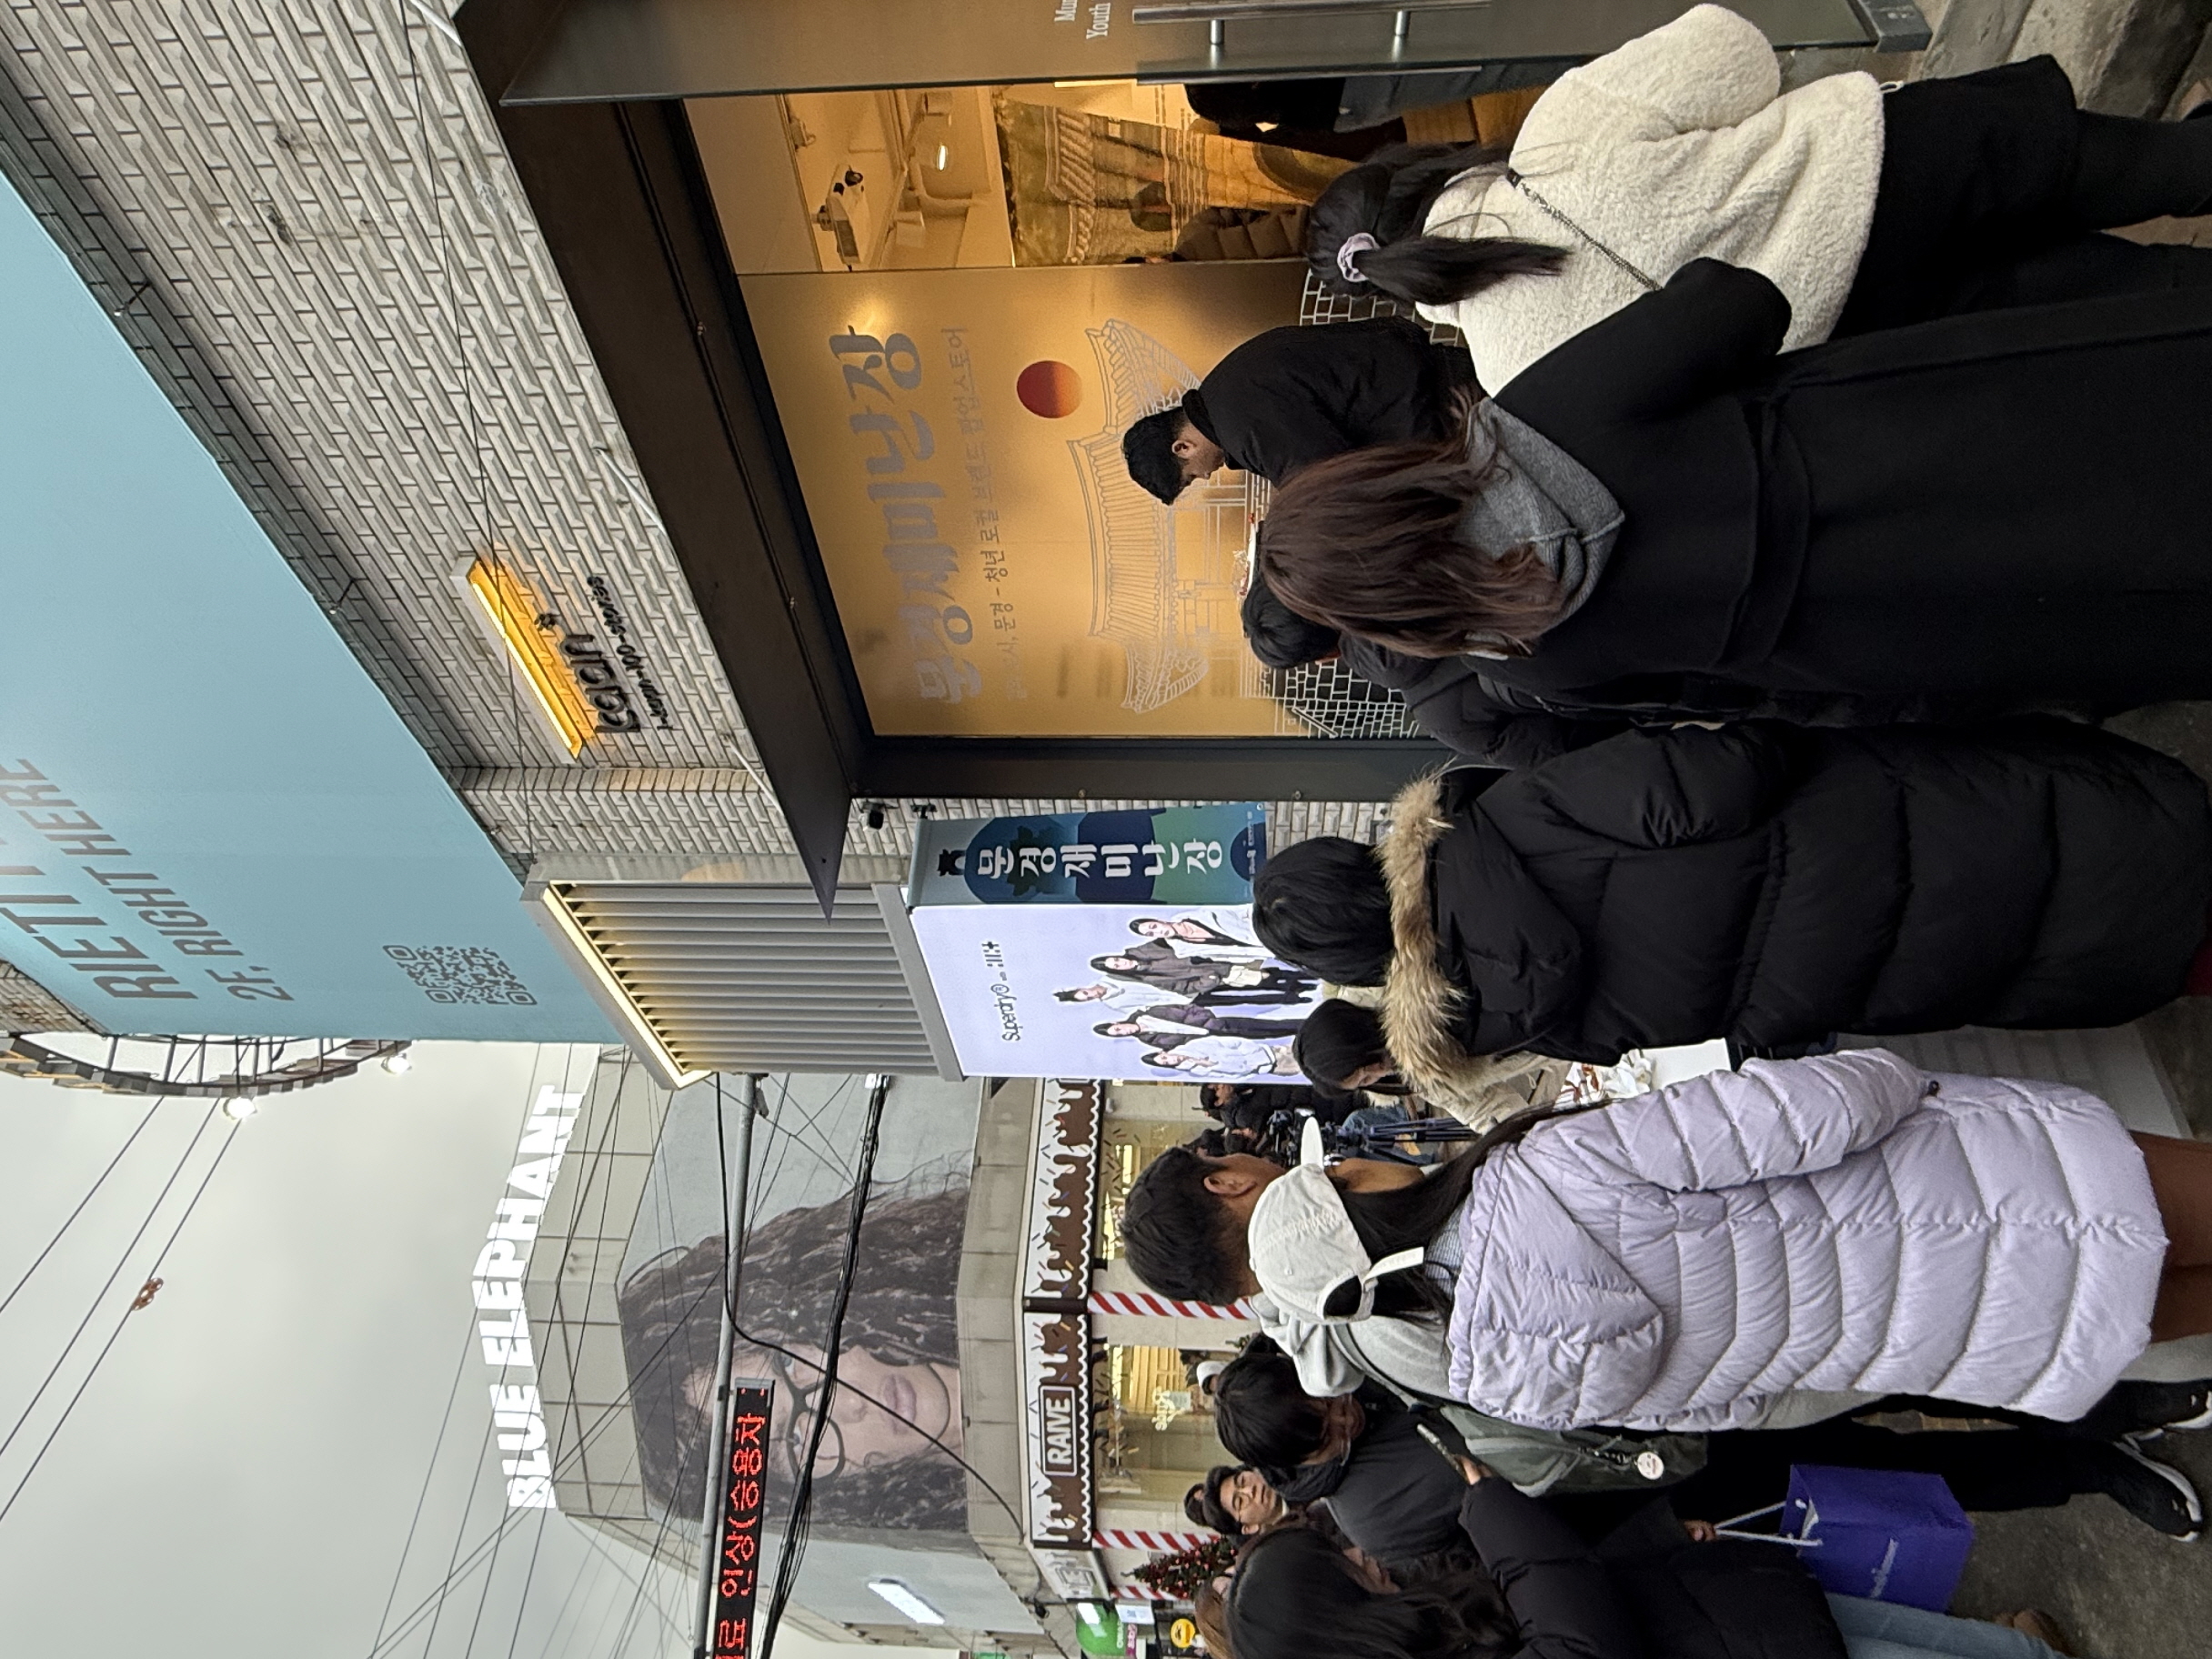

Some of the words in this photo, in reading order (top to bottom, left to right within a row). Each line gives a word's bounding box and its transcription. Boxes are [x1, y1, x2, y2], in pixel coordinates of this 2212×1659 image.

[1085, 2, 1111, 40] Youth
[829, 325, 982, 704] 문경재미난장
[980, 550, 1009, 582] 청년
[989, 601, 1017, 631] 문경
[0, 759, 131, 855] HERE
[977, 838, 1223, 880] 문경재미난장
[82, 865, 244, 956] RIGHT
[205, 965, 295, 1000] 2F,
[470, 1083, 585, 1368] ELEPHANT
[489, 1383, 557, 1509] BLUE
[1045, 1396, 1072, 1465] RAIVE
[715, 1617, 748, 1659] 료
